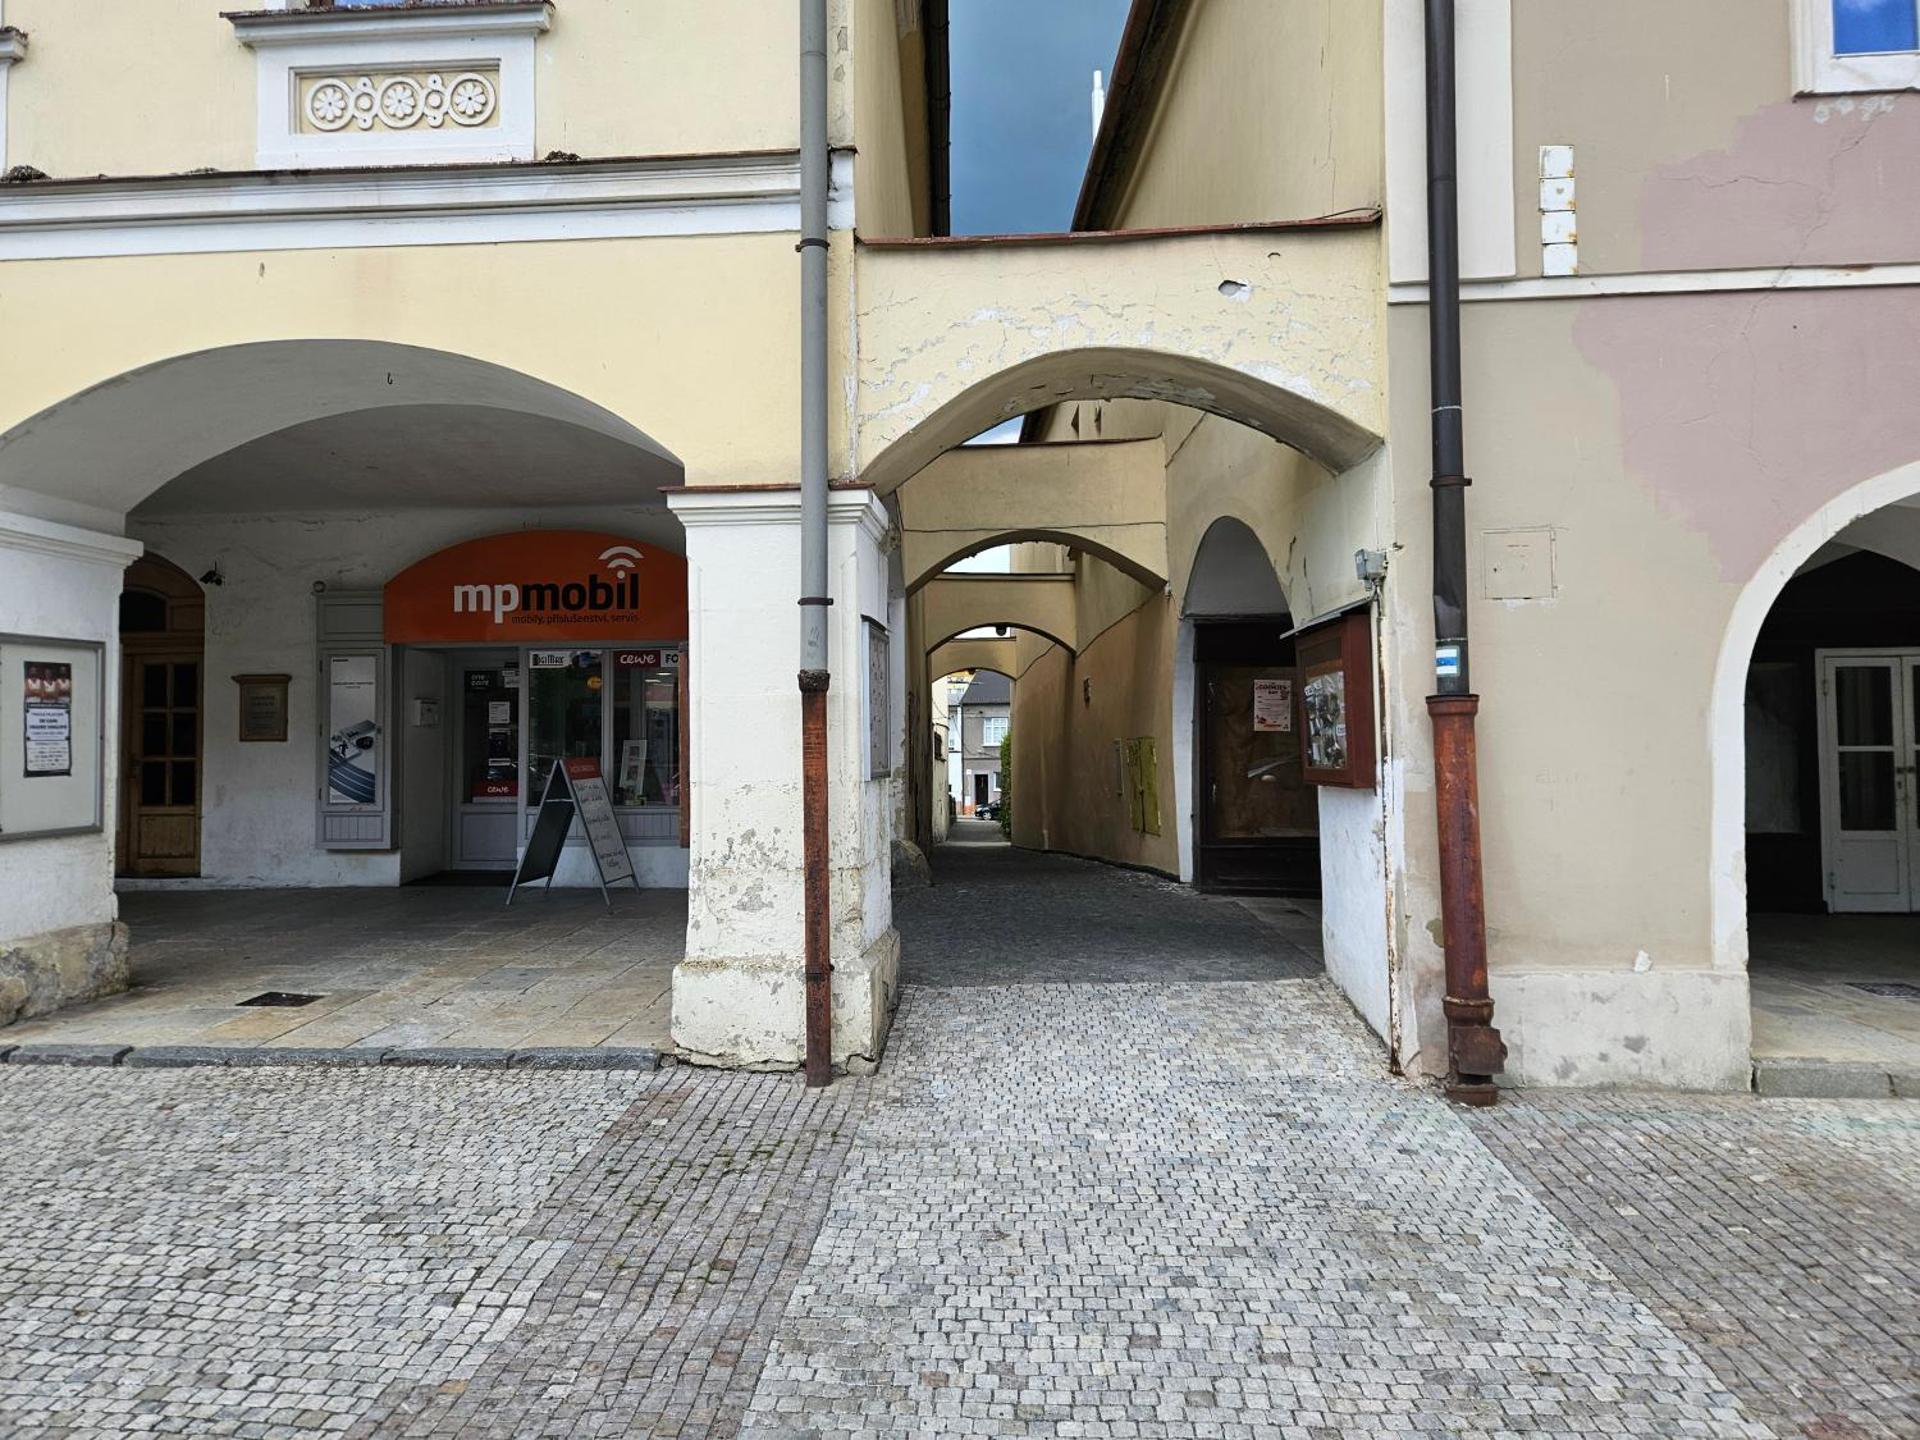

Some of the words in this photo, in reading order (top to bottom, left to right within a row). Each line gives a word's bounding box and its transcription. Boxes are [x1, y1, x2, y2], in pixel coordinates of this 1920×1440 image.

[453, 570, 639, 624] mpmobil
[620, 654, 656, 664] cewe
[487, 786, 510, 794] cewe
